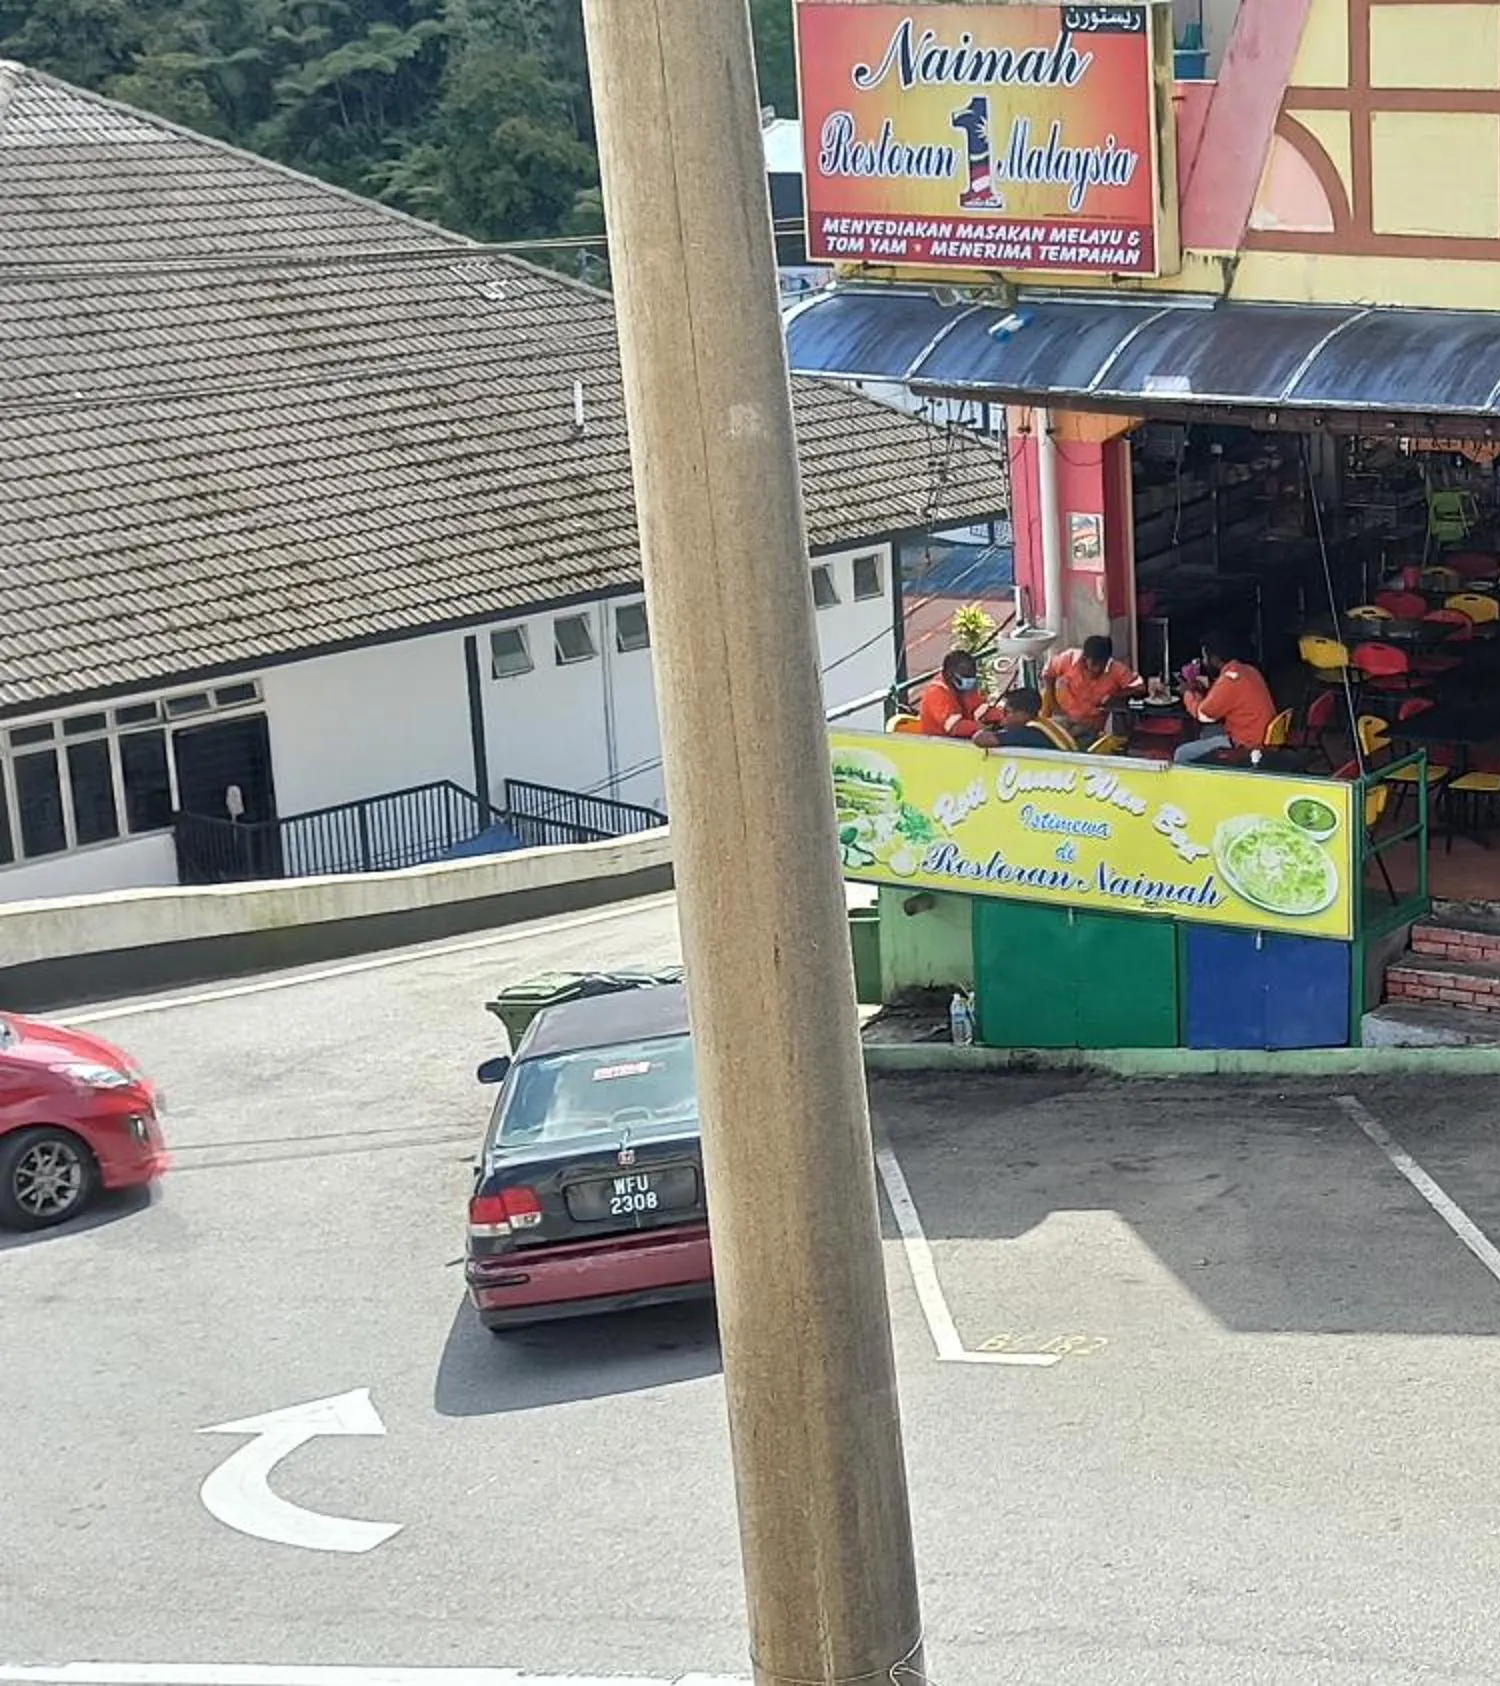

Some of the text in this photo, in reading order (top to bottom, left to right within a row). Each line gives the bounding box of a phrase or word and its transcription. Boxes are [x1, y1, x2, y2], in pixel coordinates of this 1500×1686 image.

[1065, 7, 1141, 31] ريستورن
[852, 16, 1092, 90] Naimah
[819, 96, 1137, 211] Restoran 1 Malaysia
[822, 218, 1141, 247] MENYEDIAKAN MASAKAN MELAYU &
[826, 236, 1141, 265] TOM YAM MENERIMA TEMPAHAN
[1020, 804, 1112, 840] Istimewa
[922, 844, 1226, 910] Restoran Naimah
[613, 1174, 649, 1195] WFU
[610, 1191, 658, 1215] 2308
